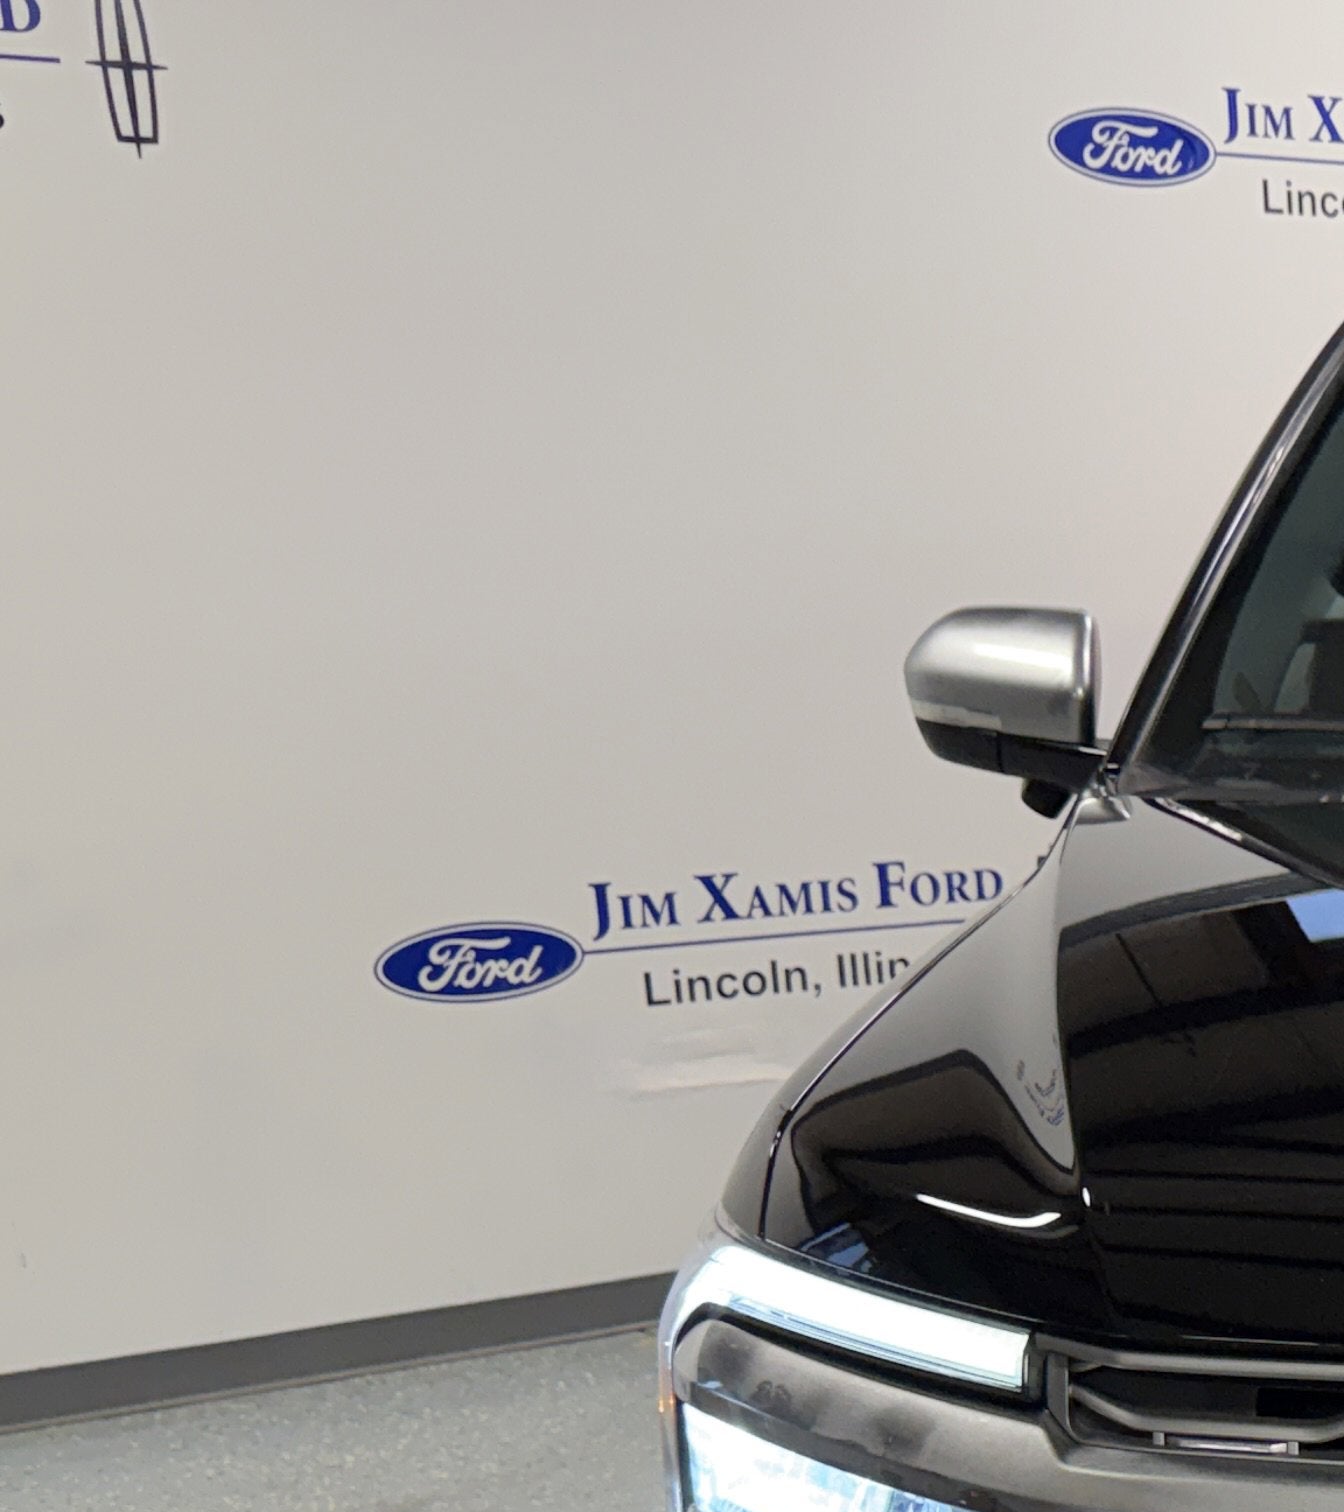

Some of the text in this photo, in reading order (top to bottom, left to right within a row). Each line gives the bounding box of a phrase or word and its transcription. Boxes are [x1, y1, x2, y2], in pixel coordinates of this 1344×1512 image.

[1221, 87, 1295, 144] JIM
[1082, 120, 1184, 176] Ford
[588, 860, 1003, 942] JIM XAMIS FORD
[417, 936, 544, 991] Ford
[643, 953, 910, 1008] Lincoln, Illin
